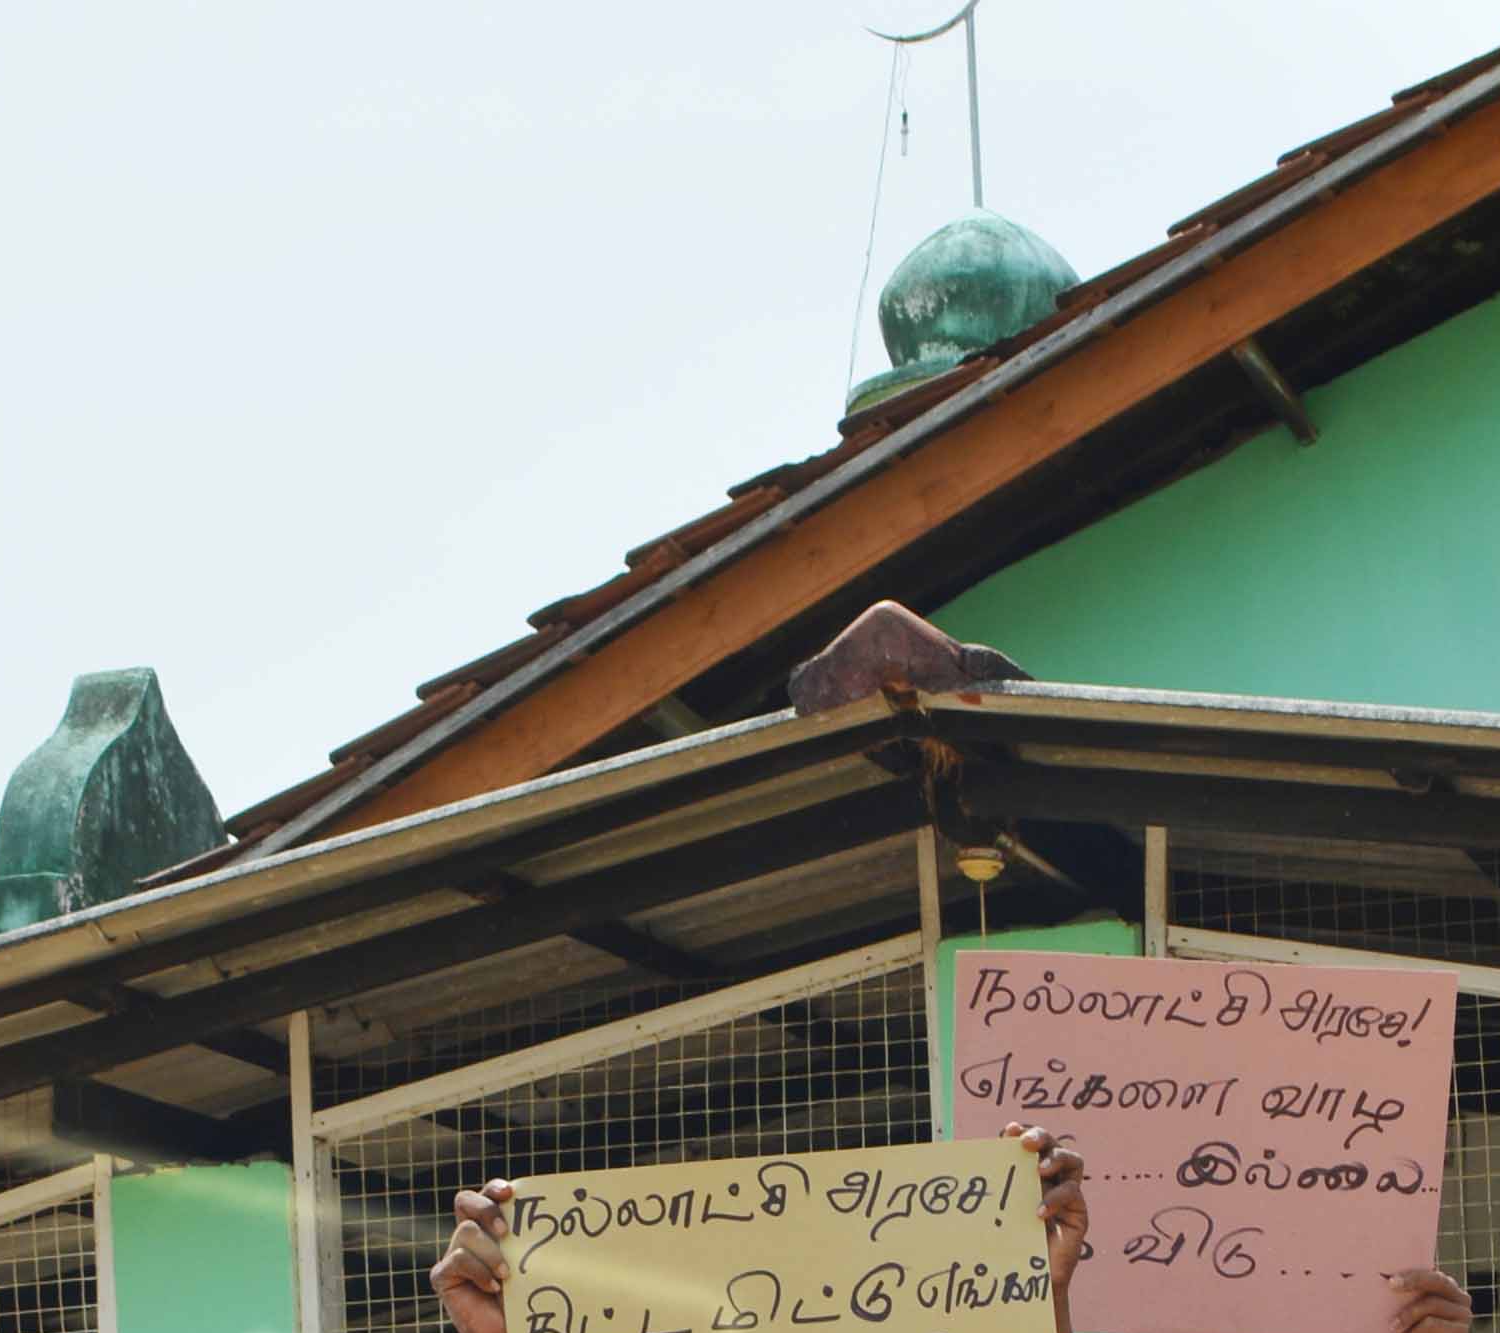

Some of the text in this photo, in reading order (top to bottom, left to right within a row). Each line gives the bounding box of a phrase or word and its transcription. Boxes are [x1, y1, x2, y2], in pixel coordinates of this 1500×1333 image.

[969, 968, 1432, 1048] நல்லாட்சி அரசே!
[960, 1053, 1405, 1150] எங்களை வாழ
[510, 1161, 1016, 1274] நல்லாட்சி அரசே!
[916, 1255, 1051, 1315] எங்கள்
